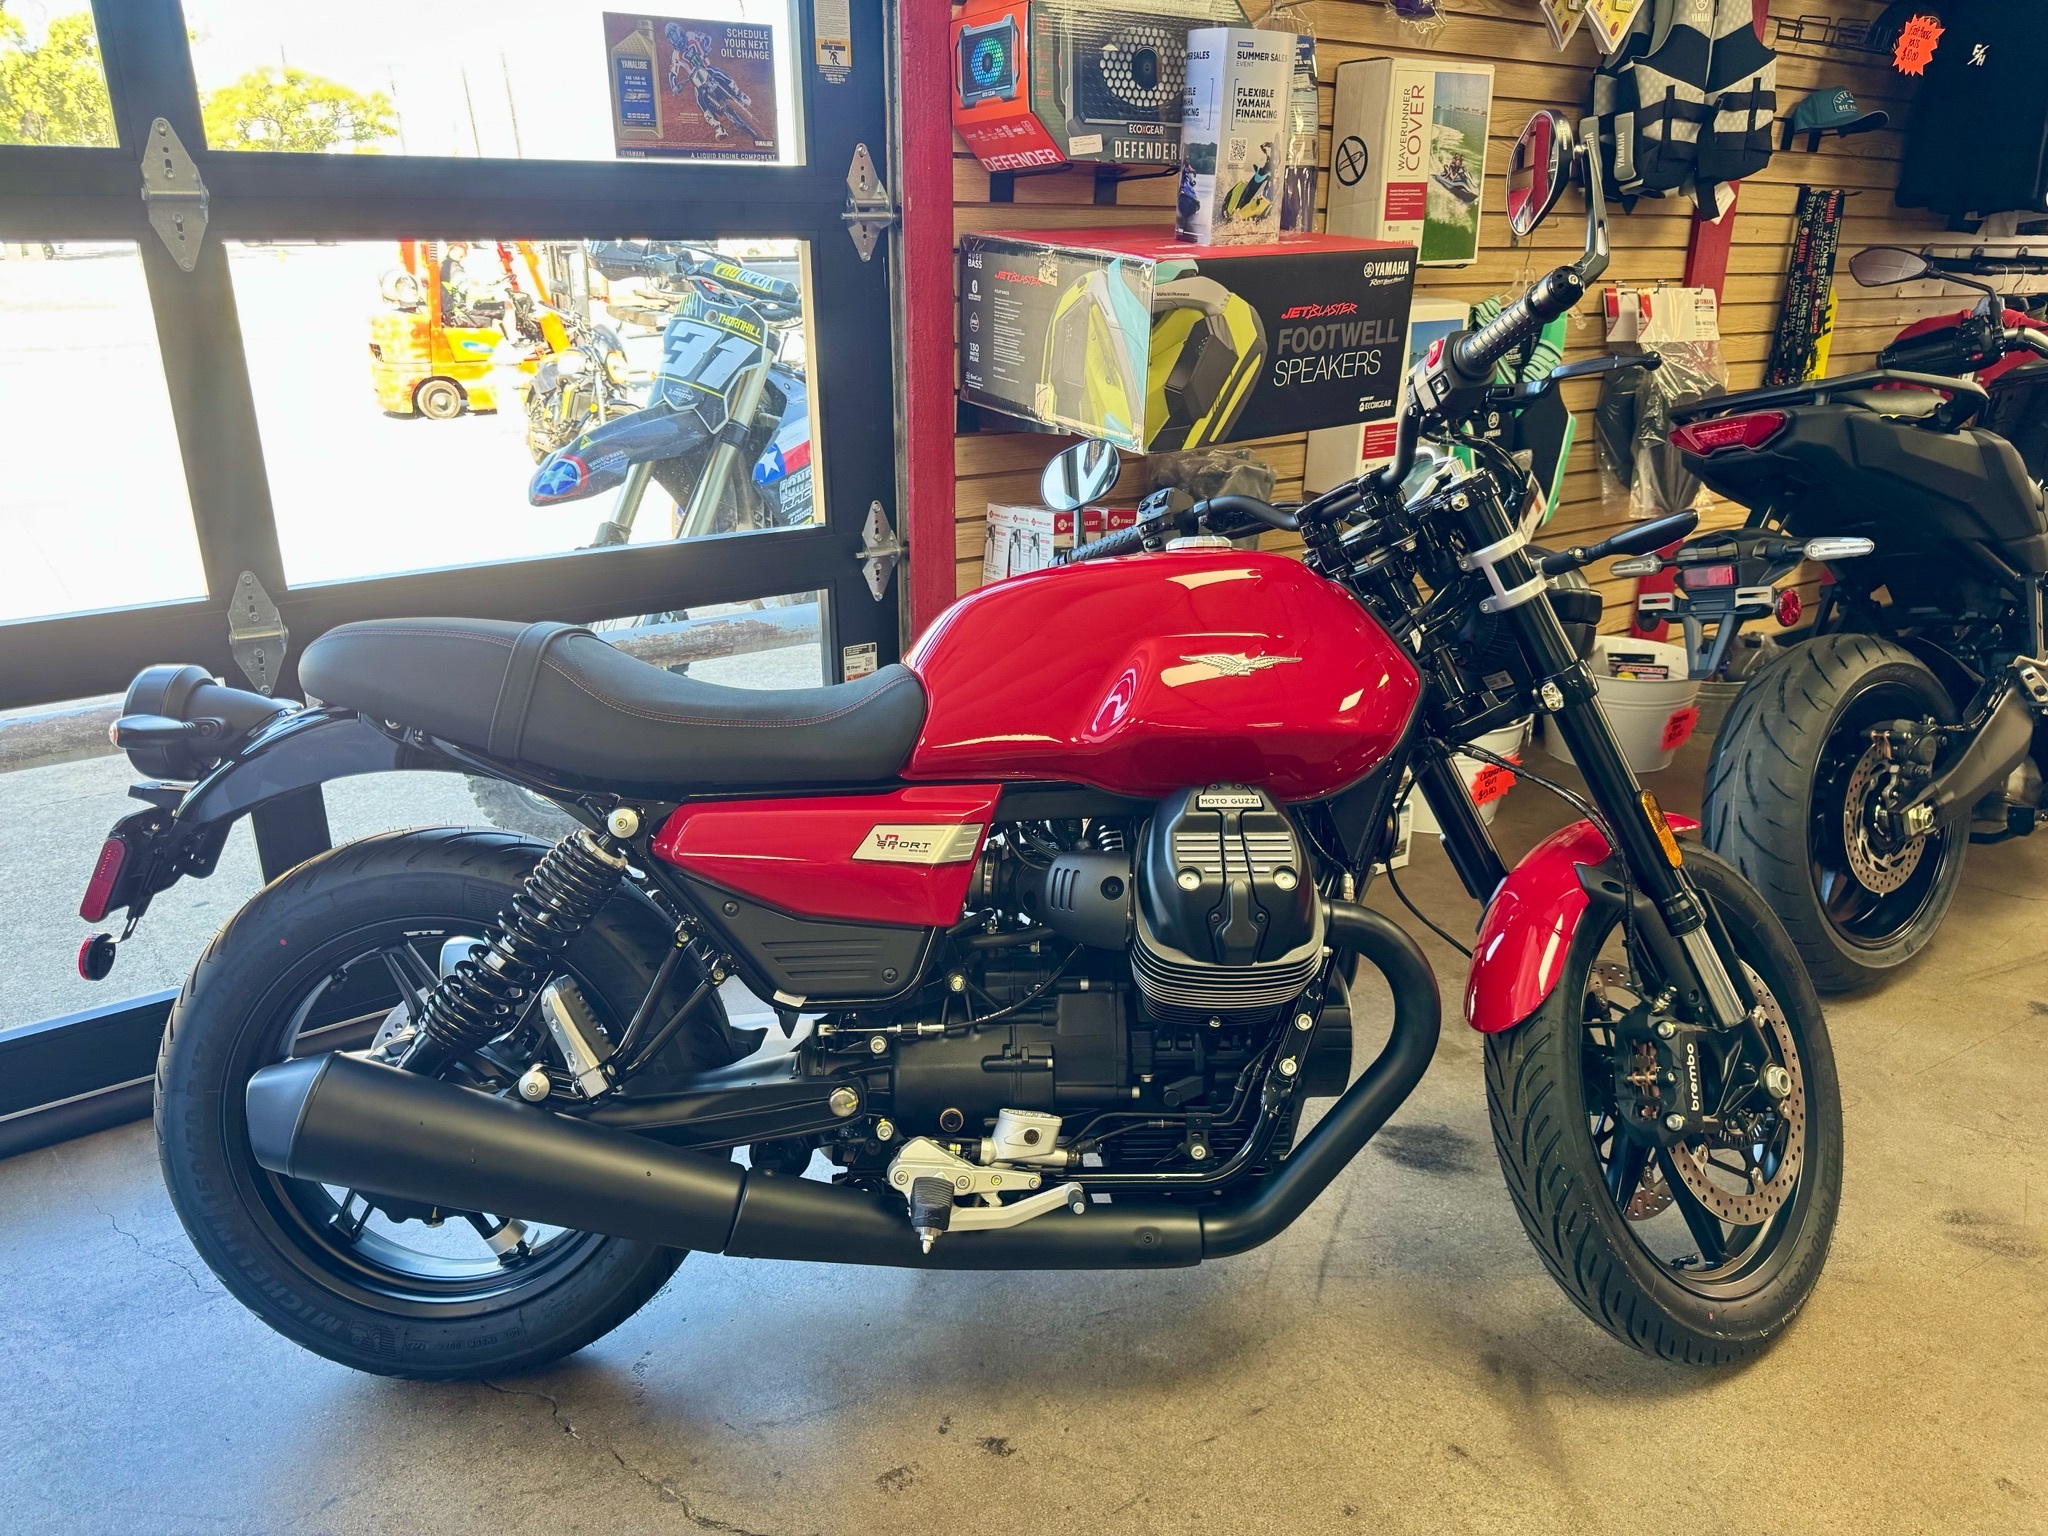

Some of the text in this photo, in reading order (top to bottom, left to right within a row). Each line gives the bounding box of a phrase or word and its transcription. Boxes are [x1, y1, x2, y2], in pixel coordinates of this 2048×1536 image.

[726, 28, 769, 40] SCHEDULE
[724, 38, 769, 50] YOUR NEXT
[721, 48, 770, 60] OIL CHANGE
[1193, 51, 1210, 60] SALES
[1237, 51, 1288, 63] SUMMER SALES
[621, 60, 648, 69] YAMALUBE
[1237, 87, 1275, 98] FLEXIBLE
[1835, 92, 1849, 104] LIVE
[1237, 98, 1271, 108] YAMAHA
[1235, 109, 1278, 119] FINANCING
[1129, 124, 1164, 135] ECOXGEAR
[1397, 88, 1411, 172] WAVERUNNER
[1405, 85, 1425, 171] COVER
[740, 153, 776, 161] COMPONENT
[1114, 140, 1178, 160] DEFENDER
[1617, 132, 1626, 168] YAMAHA
[980, 148, 1062, 172] DEFENDER
[1825, 195, 1837, 223] YAMAHA
[1797, 235, 1808, 263] YAMAHA
[1818, 241, 1831, 267] LONE
[968, 259, 983, 269] BASS
[1375, 260, 1410, 277] YAMAHA
[994, 270, 1042, 287] JETBLASTER
[1816, 267, 1827, 293] STAR
[1281, 302, 1358, 320] JETBLASTER
[1798, 292, 1809, 318] LONE
[717, 312, 762, 339] THORNHILL
[1277, 319, 1400, 355] FOOTWELL
[663, 321, 759, 390] 31
[969, 342, 980, 352] 130
[1273, 349, 1382, 387] SPEAKERS
[1230, 797, 1259, 805] GUZZI
[876, 840, 932, 849] SPORT
[1686, 1042, 1700, 1111] brembo
[1772, 1198, 1833, 1307] ROAD CLASSIC
[207, 1216, 345, 1336] MICHELIN
